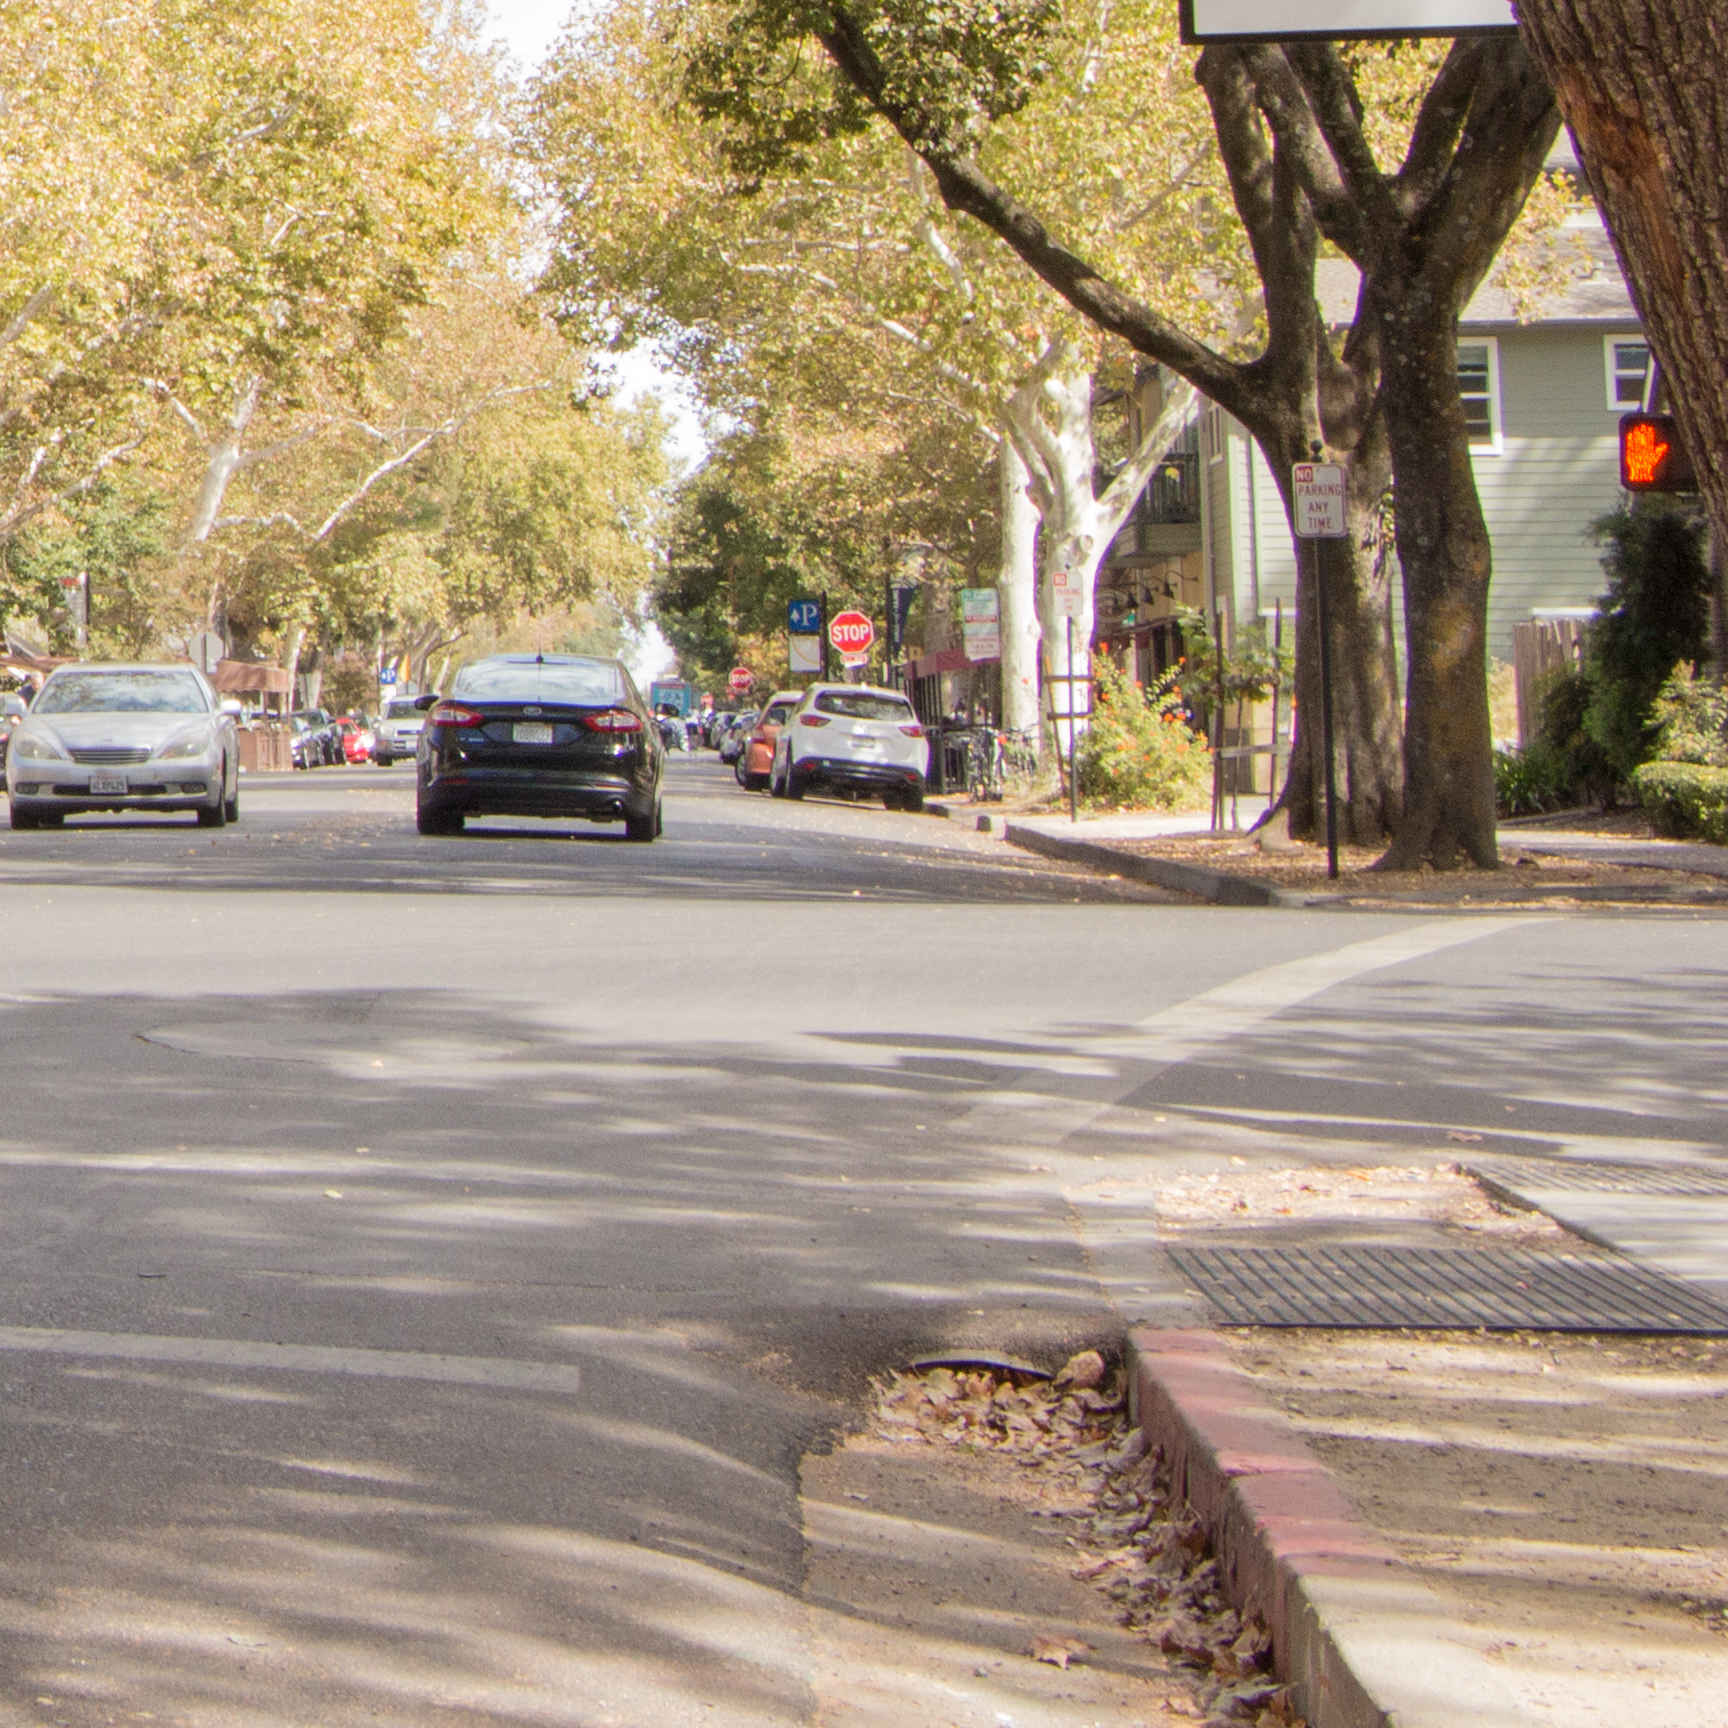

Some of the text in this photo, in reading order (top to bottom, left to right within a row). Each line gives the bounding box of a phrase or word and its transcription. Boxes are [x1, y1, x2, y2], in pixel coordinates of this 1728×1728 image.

[1296, 468, 1312, 481] NO
[1298, 484, 1342, 496] PARKING
[1308, 501, 1329, 513] ANY
[1308, 517, 1332, 529] TIME
[801, 604, 818, 626] P
[832, 624, 870, 643] STOP
